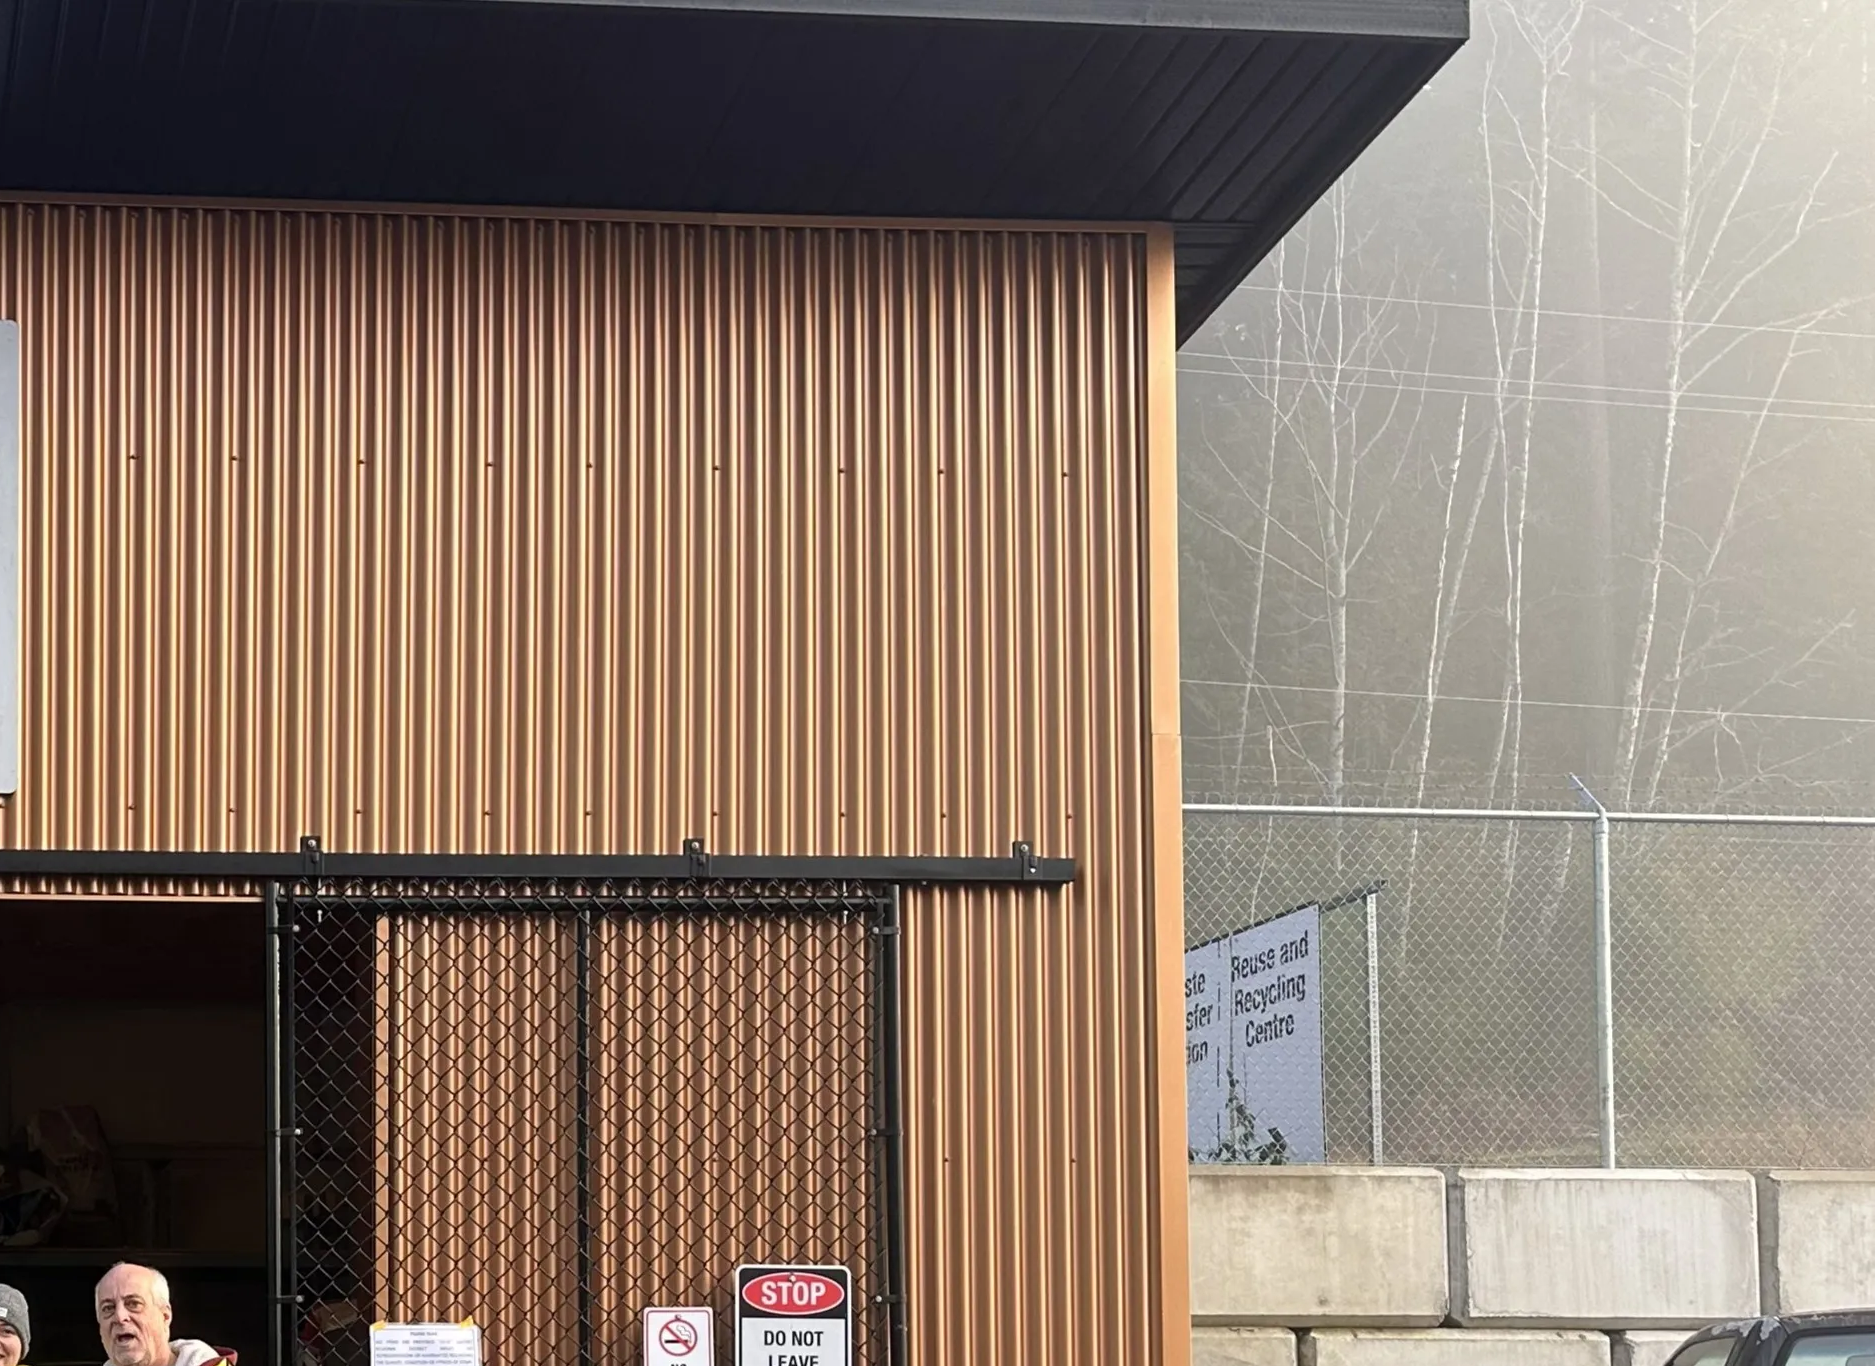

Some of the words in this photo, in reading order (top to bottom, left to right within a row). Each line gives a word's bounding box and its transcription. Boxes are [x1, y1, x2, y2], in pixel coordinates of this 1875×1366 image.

[1231, 948, 1275, 983] Reuse
[1280, 929, 1309, 965] and
[1235, 973, 1305, 1016] Recycling
[1246, 1013, 1294, 1048] Centre
[760, 1281, 826, 1306] STOP
[764, 1330, 786, 1346] DO
[791, 1331, 824, 1347] NOT
